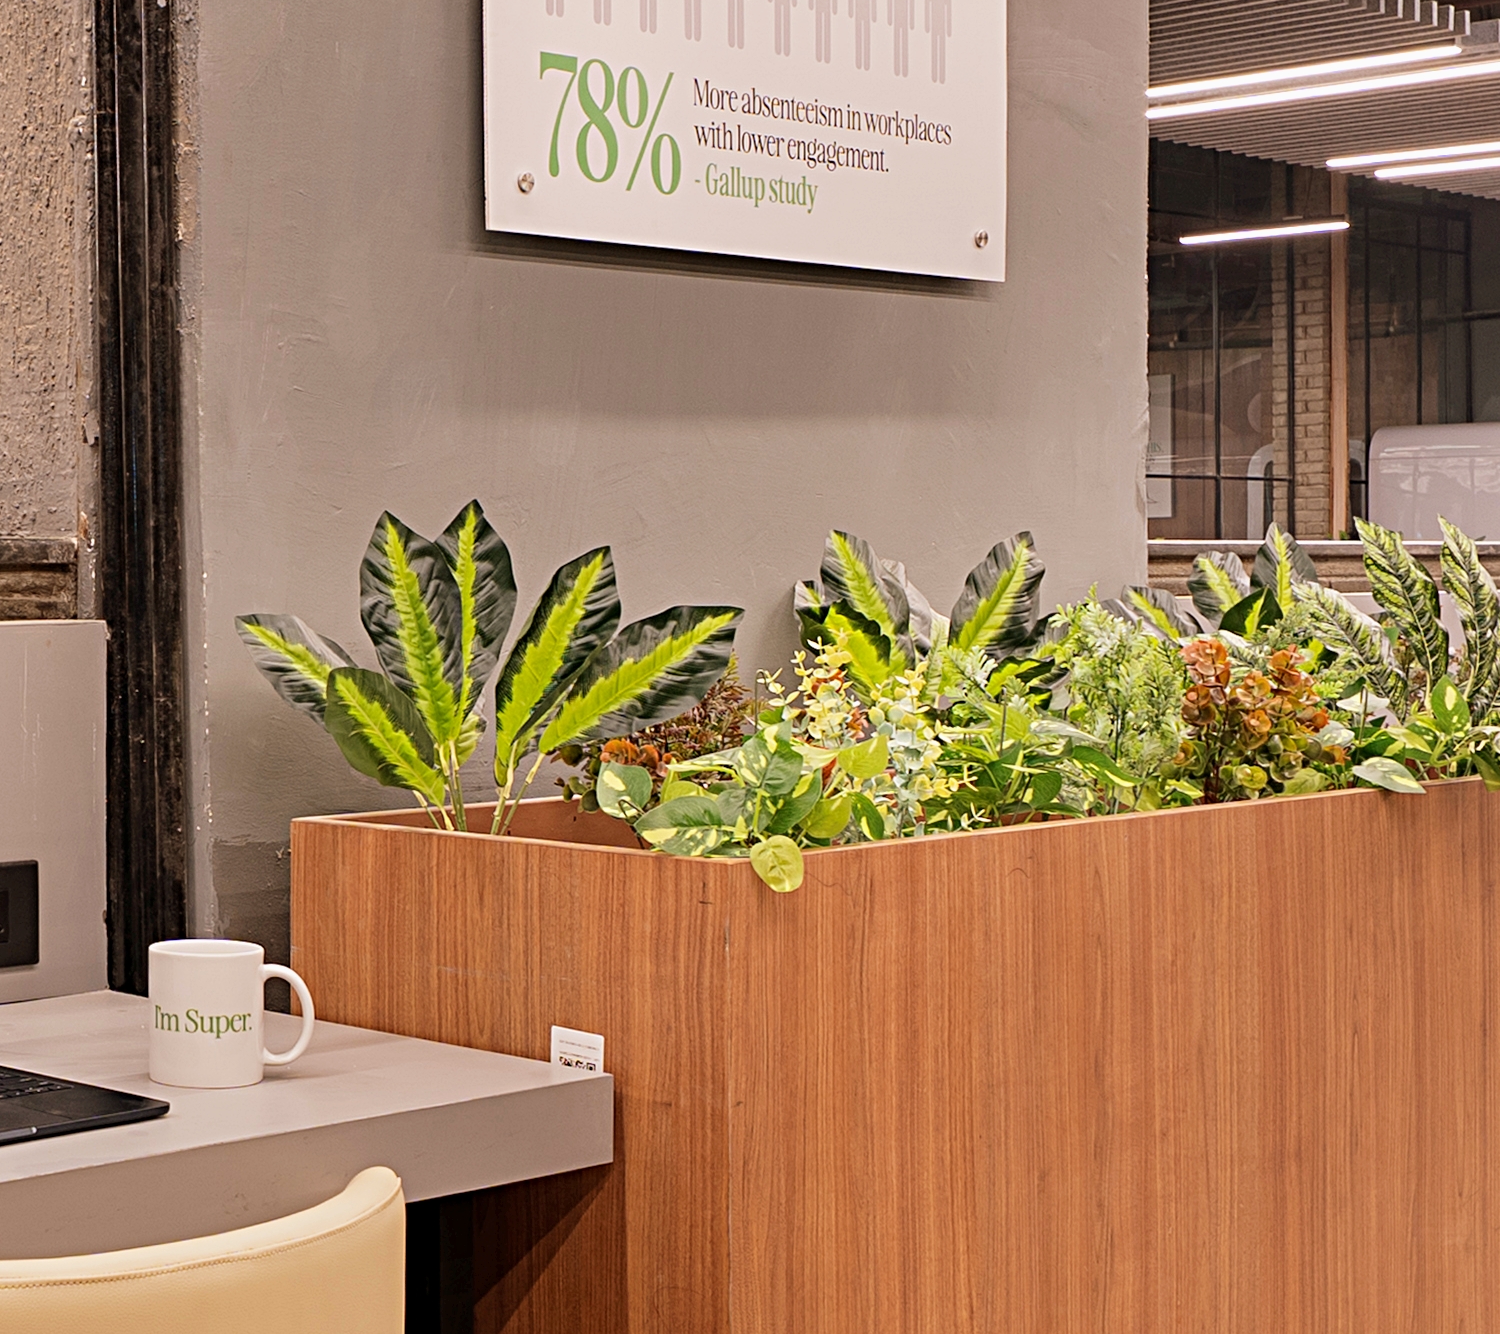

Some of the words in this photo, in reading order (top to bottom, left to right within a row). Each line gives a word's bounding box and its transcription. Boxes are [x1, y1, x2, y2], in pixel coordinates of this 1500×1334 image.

[539, 51, 682, 195] 78%
[693, 78, 738, 112] More
[742, 88, 844, 128] absenteeism
[846, 104, 862, 131] in
[864, 111, 952, 145] workplaces
[693, 122, 733, 151] with
[737, 124, 785, 158] lower
[787, 138, 889, 172] engagement.
[705, 163, 765, 208] Gallup
[769, 174, 818, 214] study
[155, 1004, 180, 1033] I'm
[185, 1008, 252, 1039] Super.
